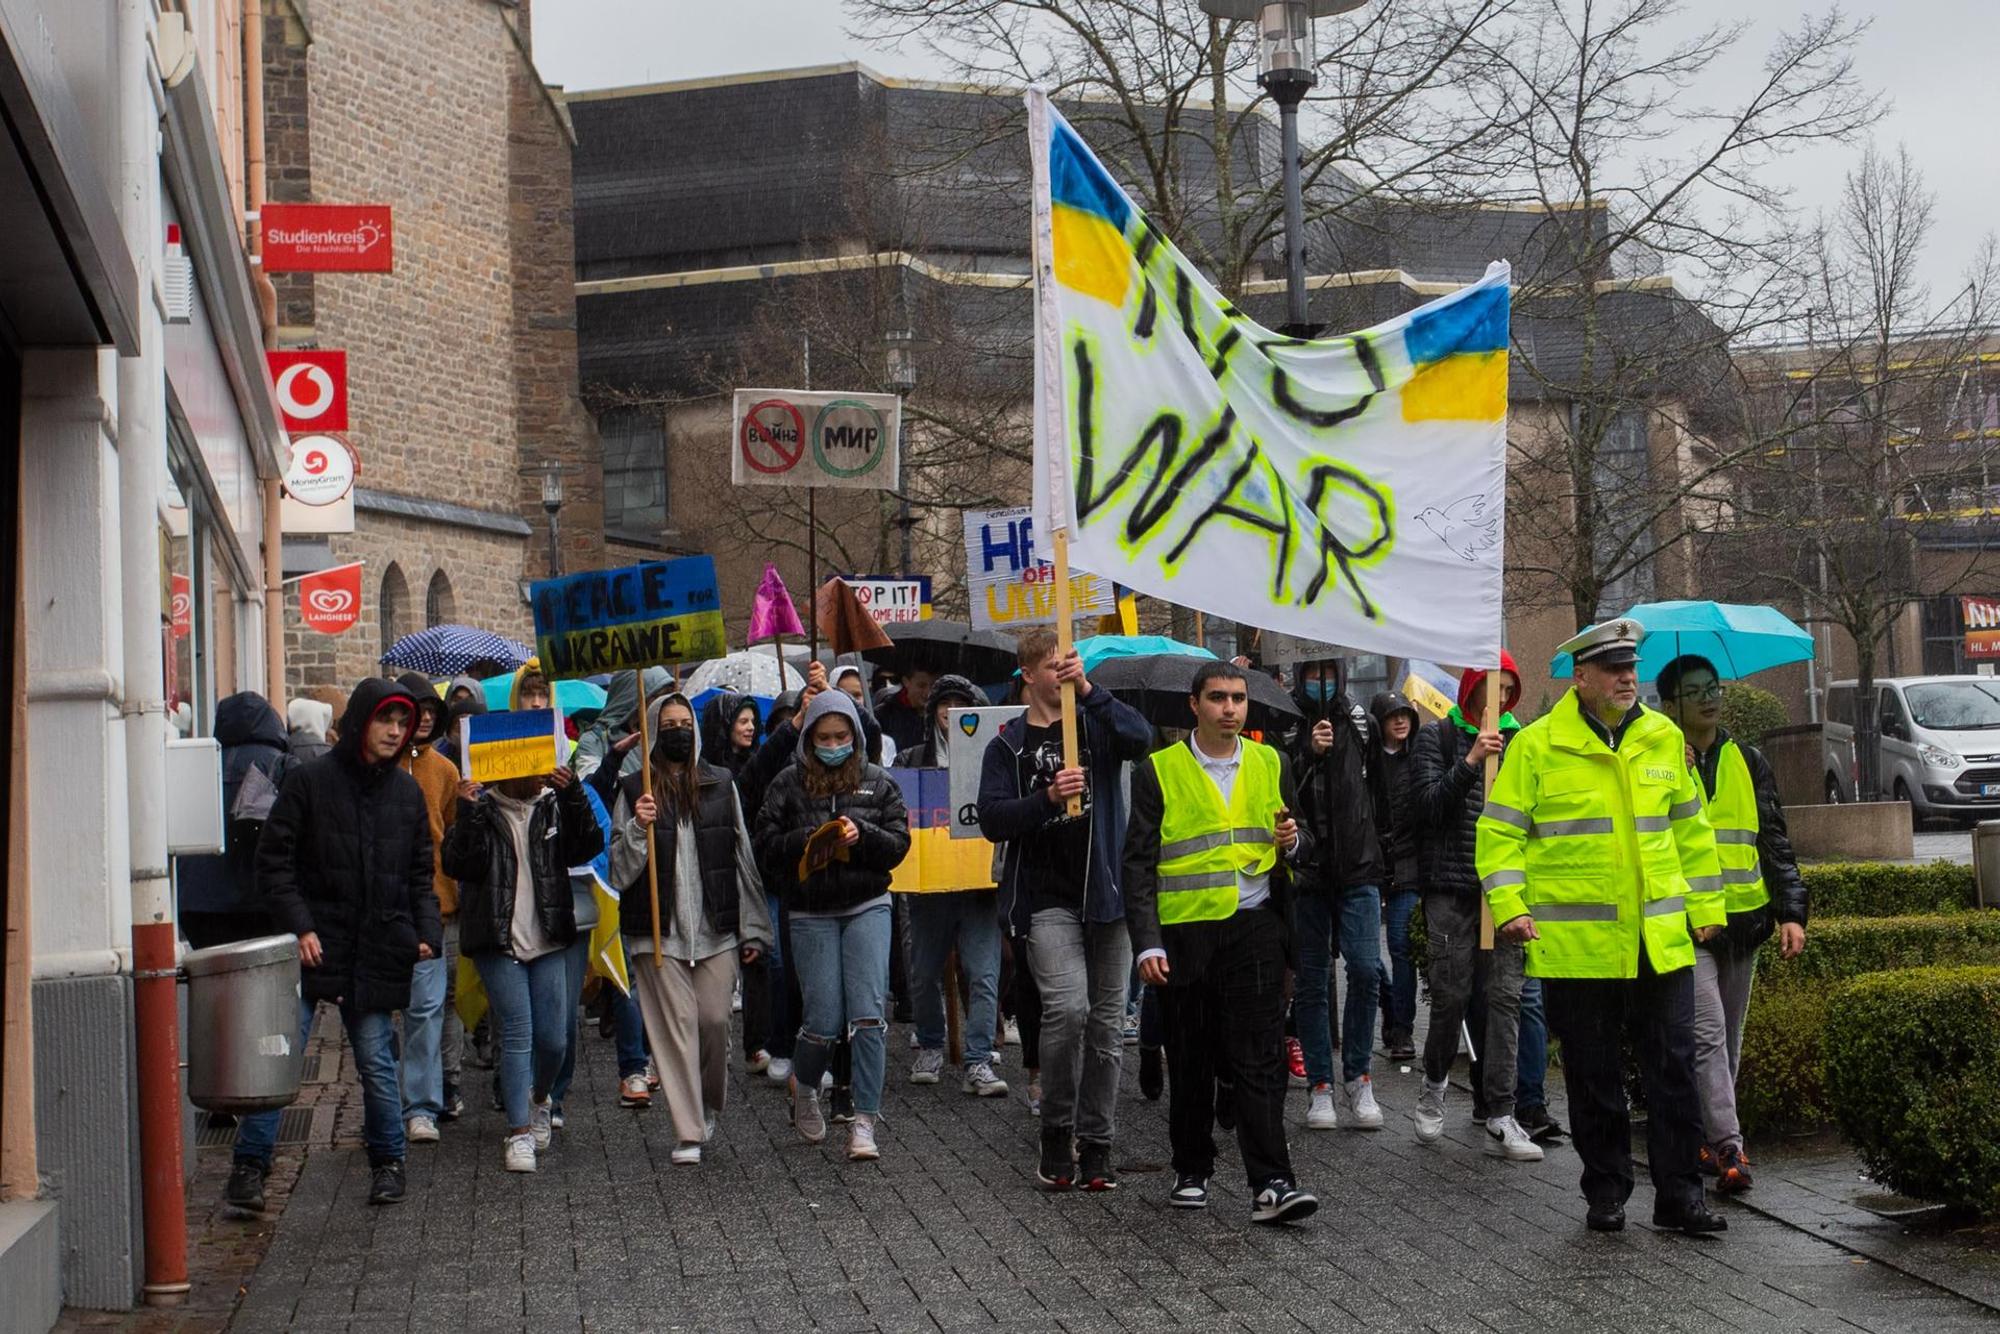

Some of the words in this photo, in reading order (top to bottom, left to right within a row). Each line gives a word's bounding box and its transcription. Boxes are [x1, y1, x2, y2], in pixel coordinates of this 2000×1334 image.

[268, 229, 365, 244] Studienkreis
[296, 245, 312, 253] Die
[291, 475, 344, 486] MoneyGram
[1074, 338, 1393, 619] WAR
[538, 565, 673, 630] PEACE
[892, 586, 918, 606] IT!
[1970, 642, 1988, 653] HL.
[1645, 768, 1676, 781] POLIZEI
